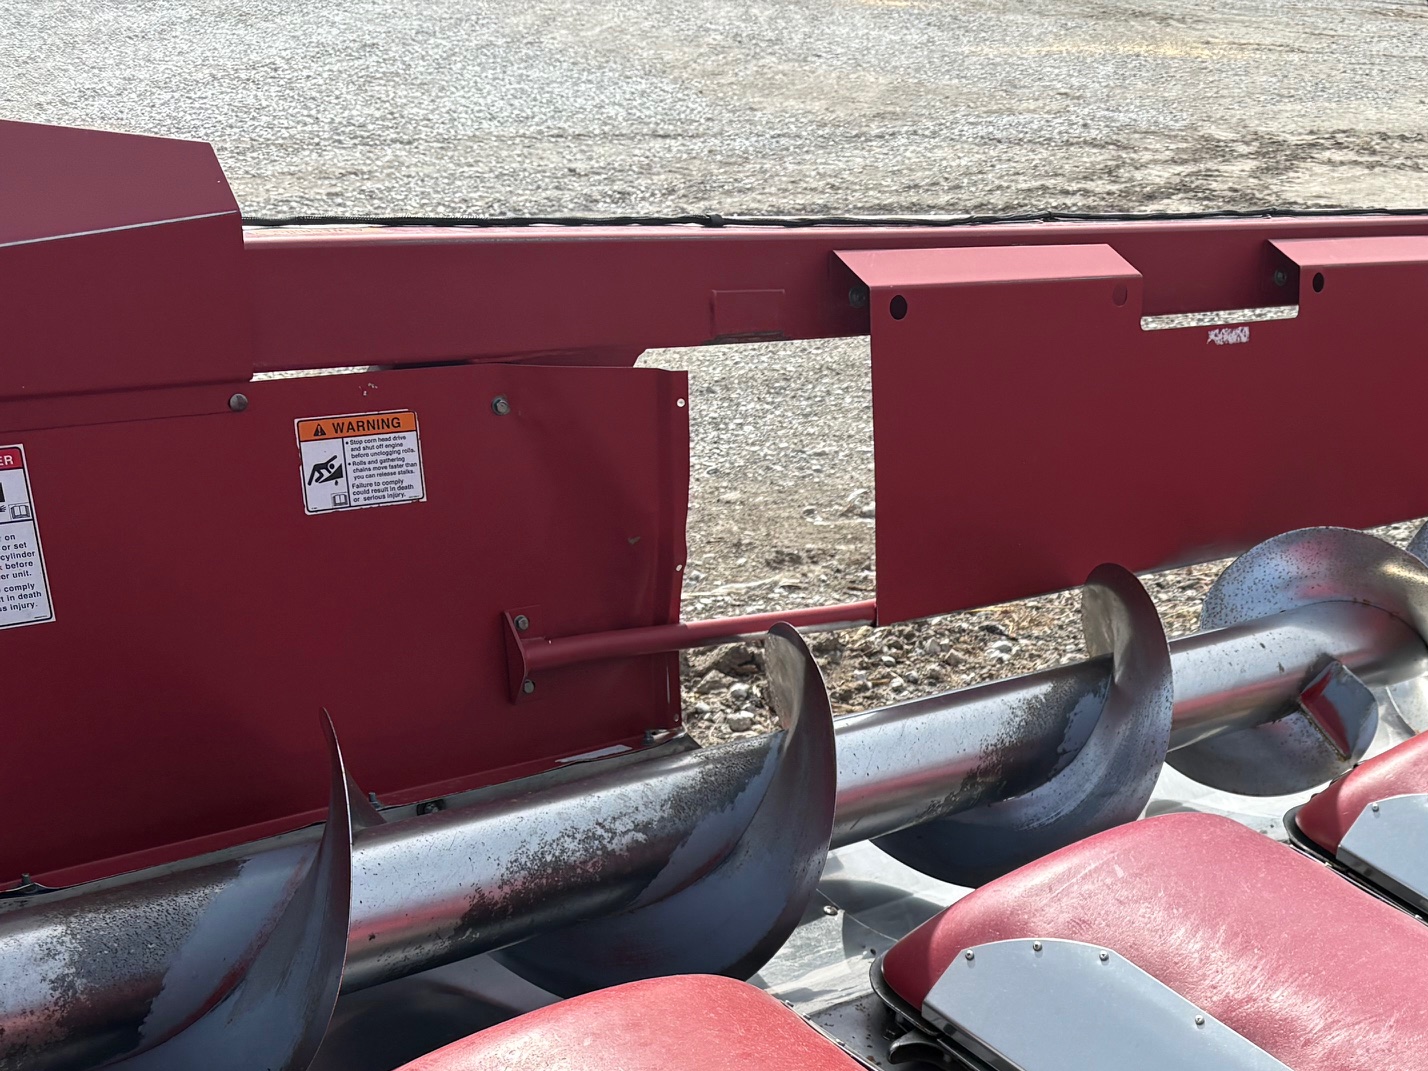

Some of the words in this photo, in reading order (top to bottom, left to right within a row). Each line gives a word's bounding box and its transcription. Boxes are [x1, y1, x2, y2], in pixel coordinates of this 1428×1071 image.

[332, 417, 401, 433] WARNING
[14, 542, 27, 550] set
[1, 551, 35, 561] cylinder
[5, 561, 33, 569] before
[12, 570, 32, 578] unit.
[4, 583, 35, 592] comply
[18, 591, 42, 600] death
[10, 602, 38, 611] injury.
